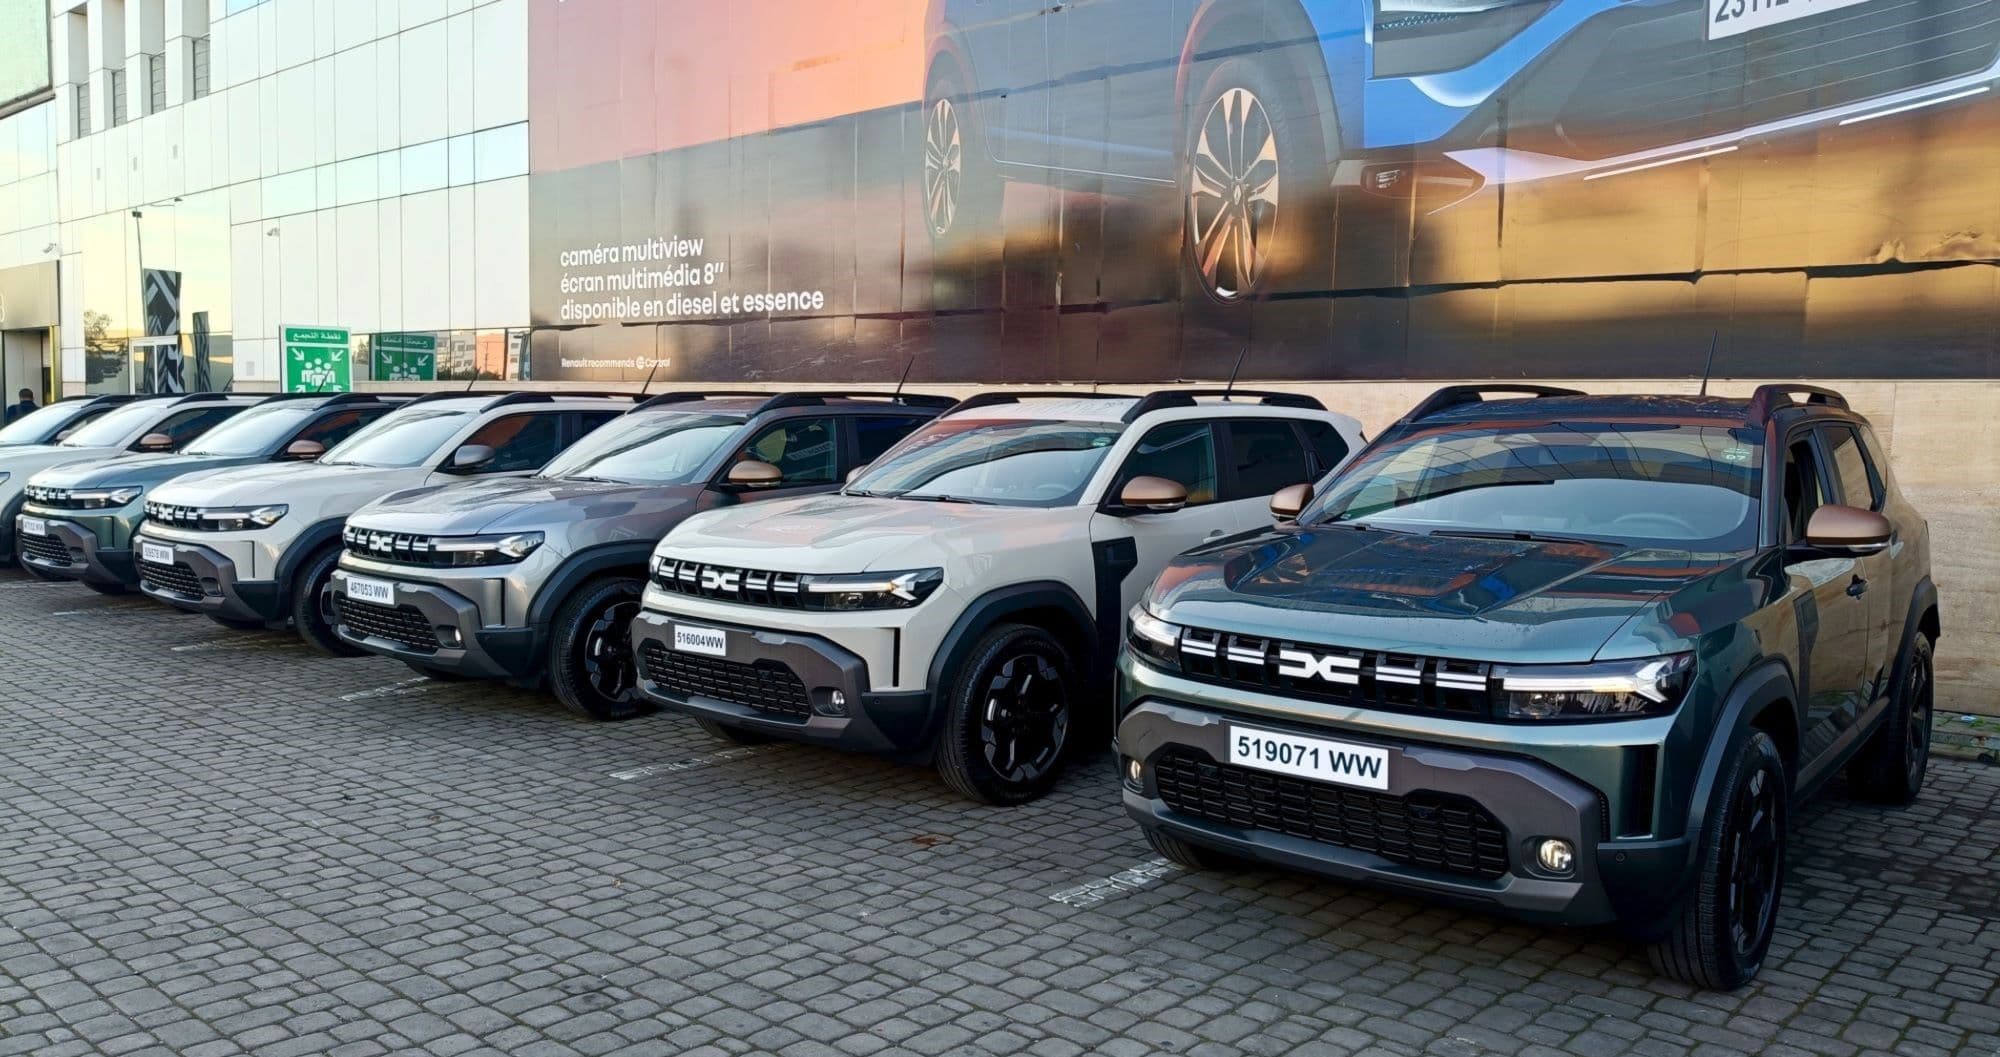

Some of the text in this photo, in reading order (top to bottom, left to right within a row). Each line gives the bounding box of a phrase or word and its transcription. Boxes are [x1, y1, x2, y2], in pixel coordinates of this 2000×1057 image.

[560, 235, 704, 267] caméra multiview
[560, 273, 604, 294] écran
[606, 263, 701, 292] multimédia
[560, 290, 825, 325] disponible en diesel et essence
[1238, 735, 1382, 779] 519071 WW
